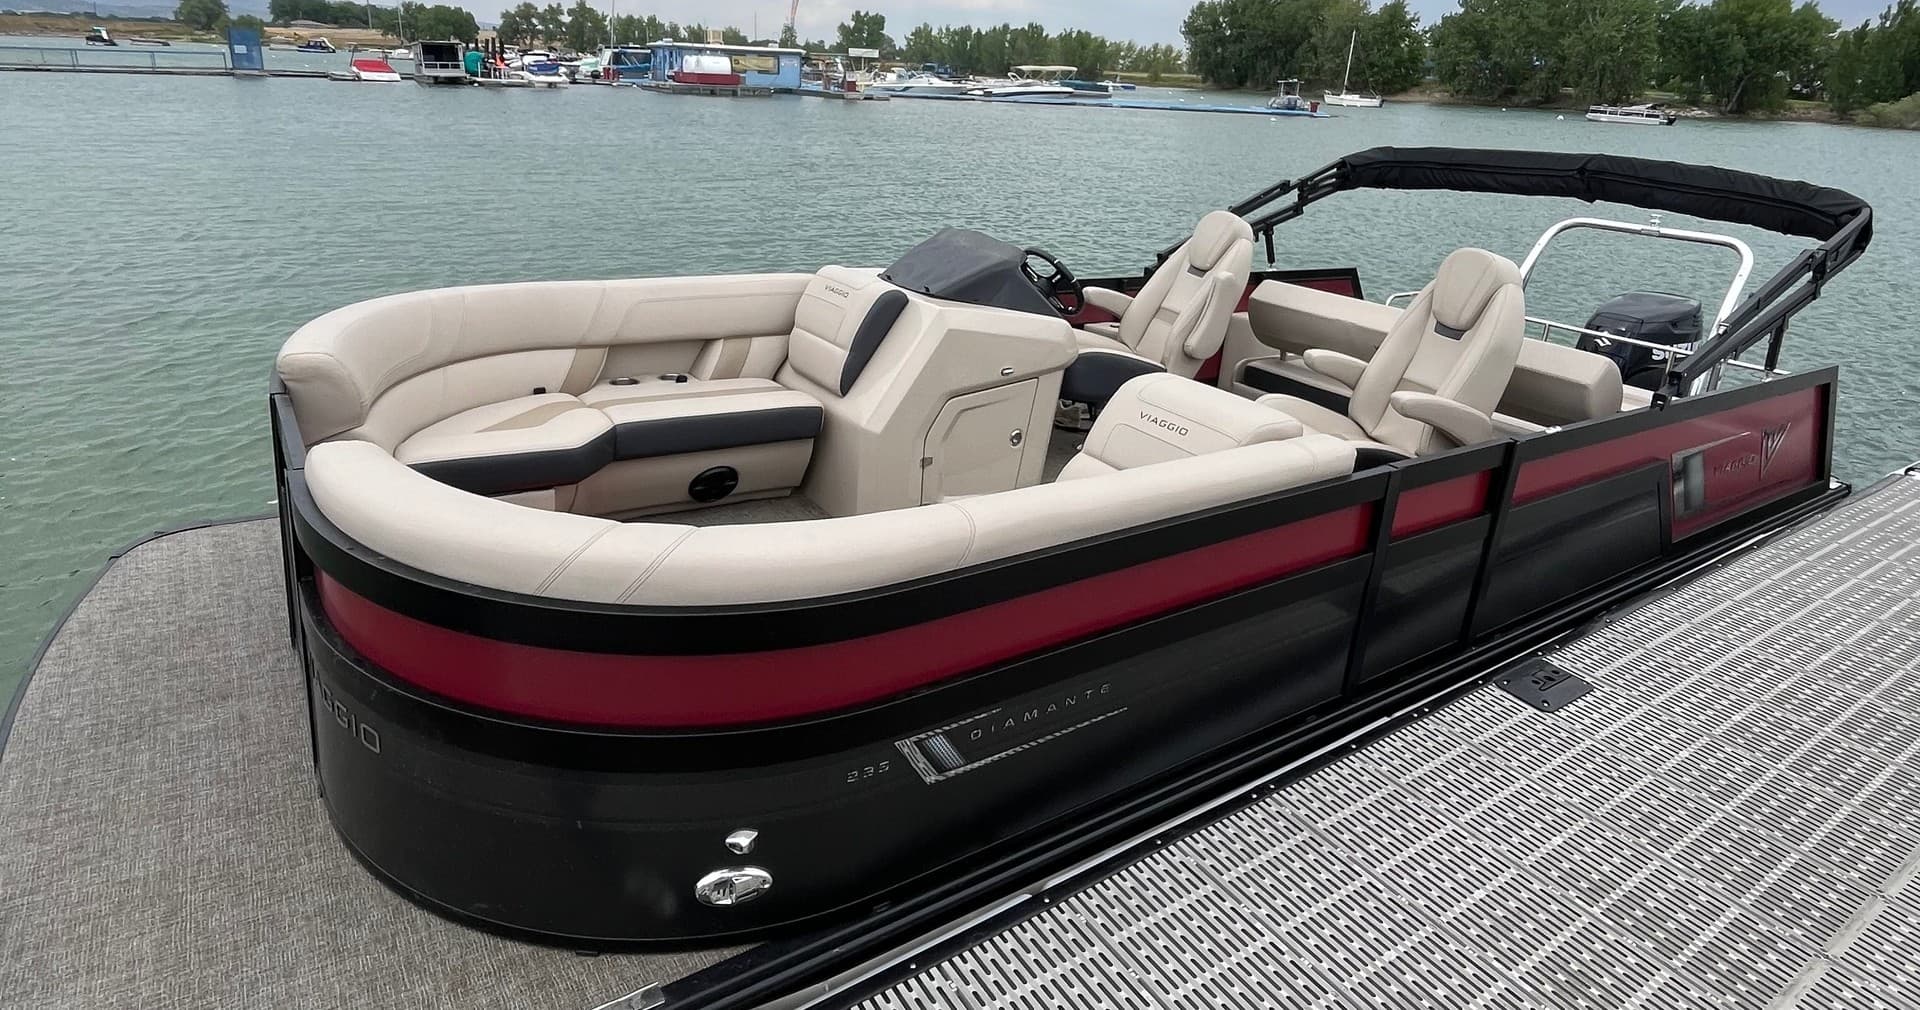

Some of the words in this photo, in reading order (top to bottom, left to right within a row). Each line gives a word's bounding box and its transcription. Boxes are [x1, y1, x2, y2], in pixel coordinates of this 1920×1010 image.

[824, 284, 850, 298] VIAGGIO
[1140, 410, 1189, 437] VIAGGIO
[968, 682, 1113, 742] DIAMANTE
[845, 760, 890, 784] 235
